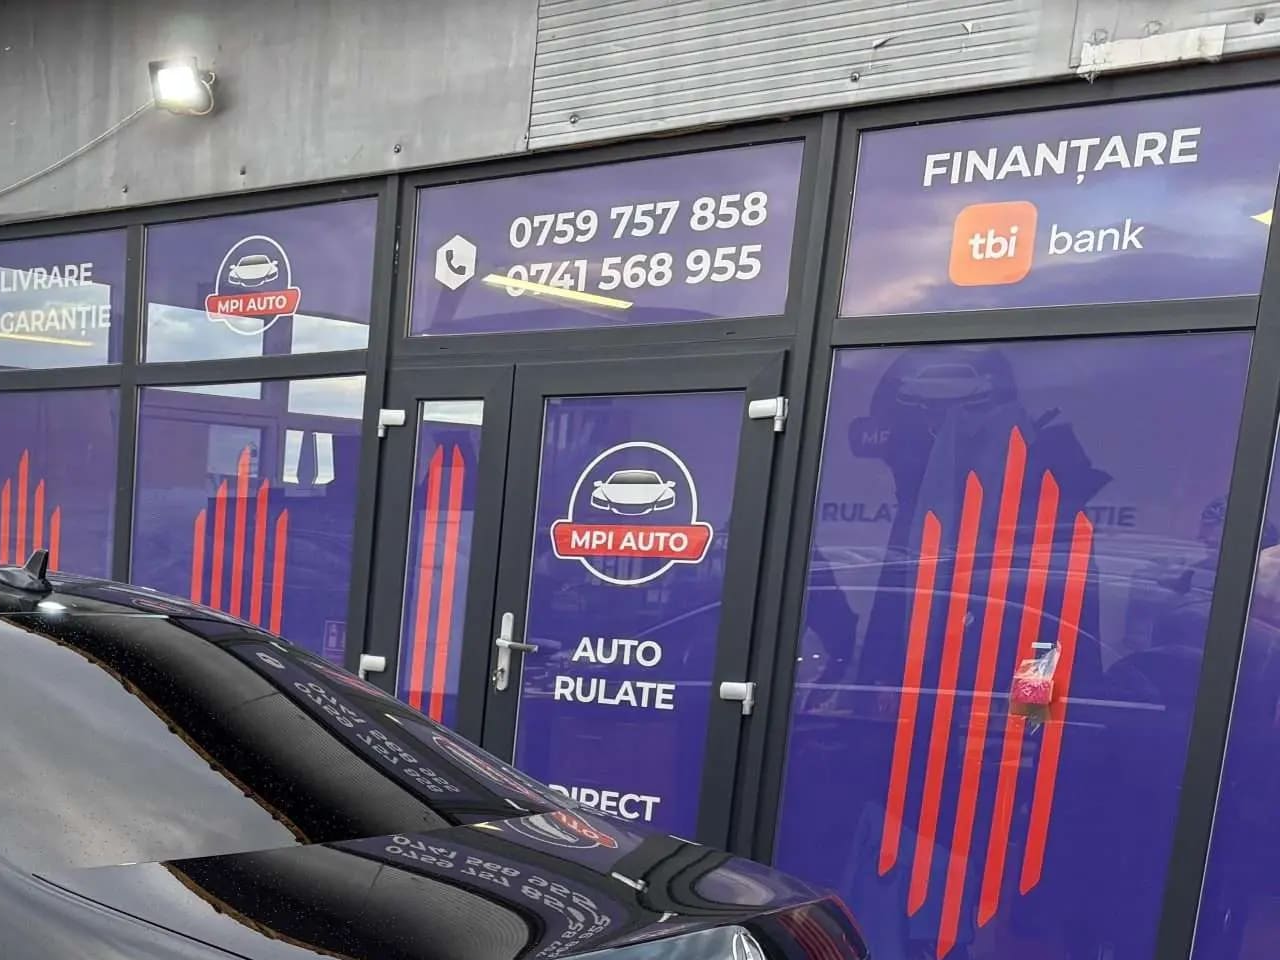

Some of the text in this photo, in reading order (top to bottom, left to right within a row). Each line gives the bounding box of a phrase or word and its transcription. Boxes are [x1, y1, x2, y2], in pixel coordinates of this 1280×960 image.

[923, 127, 1201, 187] FINANȚARE
[508, 191, 768, 249] 0759 757 858
[968, 219, 1144, 260] tbi bank
[0, 262, 94, 292] LIVRARE
[504, 244, 763, 297] 0741 568 955
[0, 304, 111, 336] GARANȚIE
[217, 294, 287, 314] MPI AUTO
[570, 530, 689, 552] MPI AUTO
[572, 636, 662, 667] AUTO
[553, 675, 676, 710] RULATE
